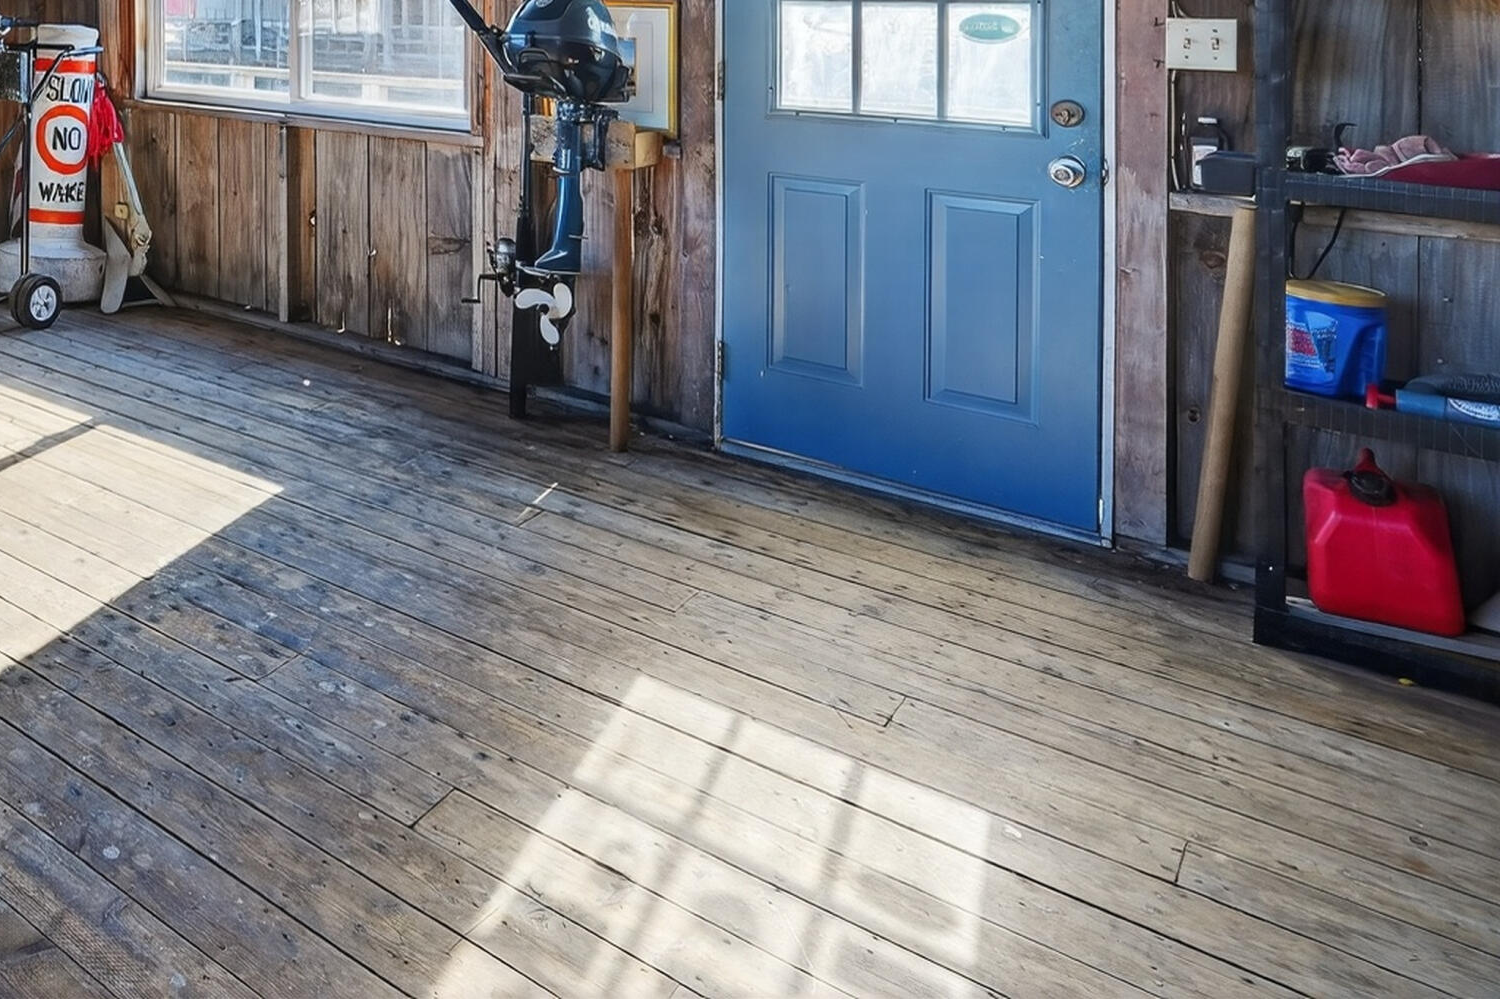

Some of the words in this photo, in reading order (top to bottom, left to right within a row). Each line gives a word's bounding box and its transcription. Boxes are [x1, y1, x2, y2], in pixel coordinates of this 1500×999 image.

[46, 74, 93, 103] SLOW
[52, 126, 81, 151] NO
[38, 181, 84, 203] WAKE
